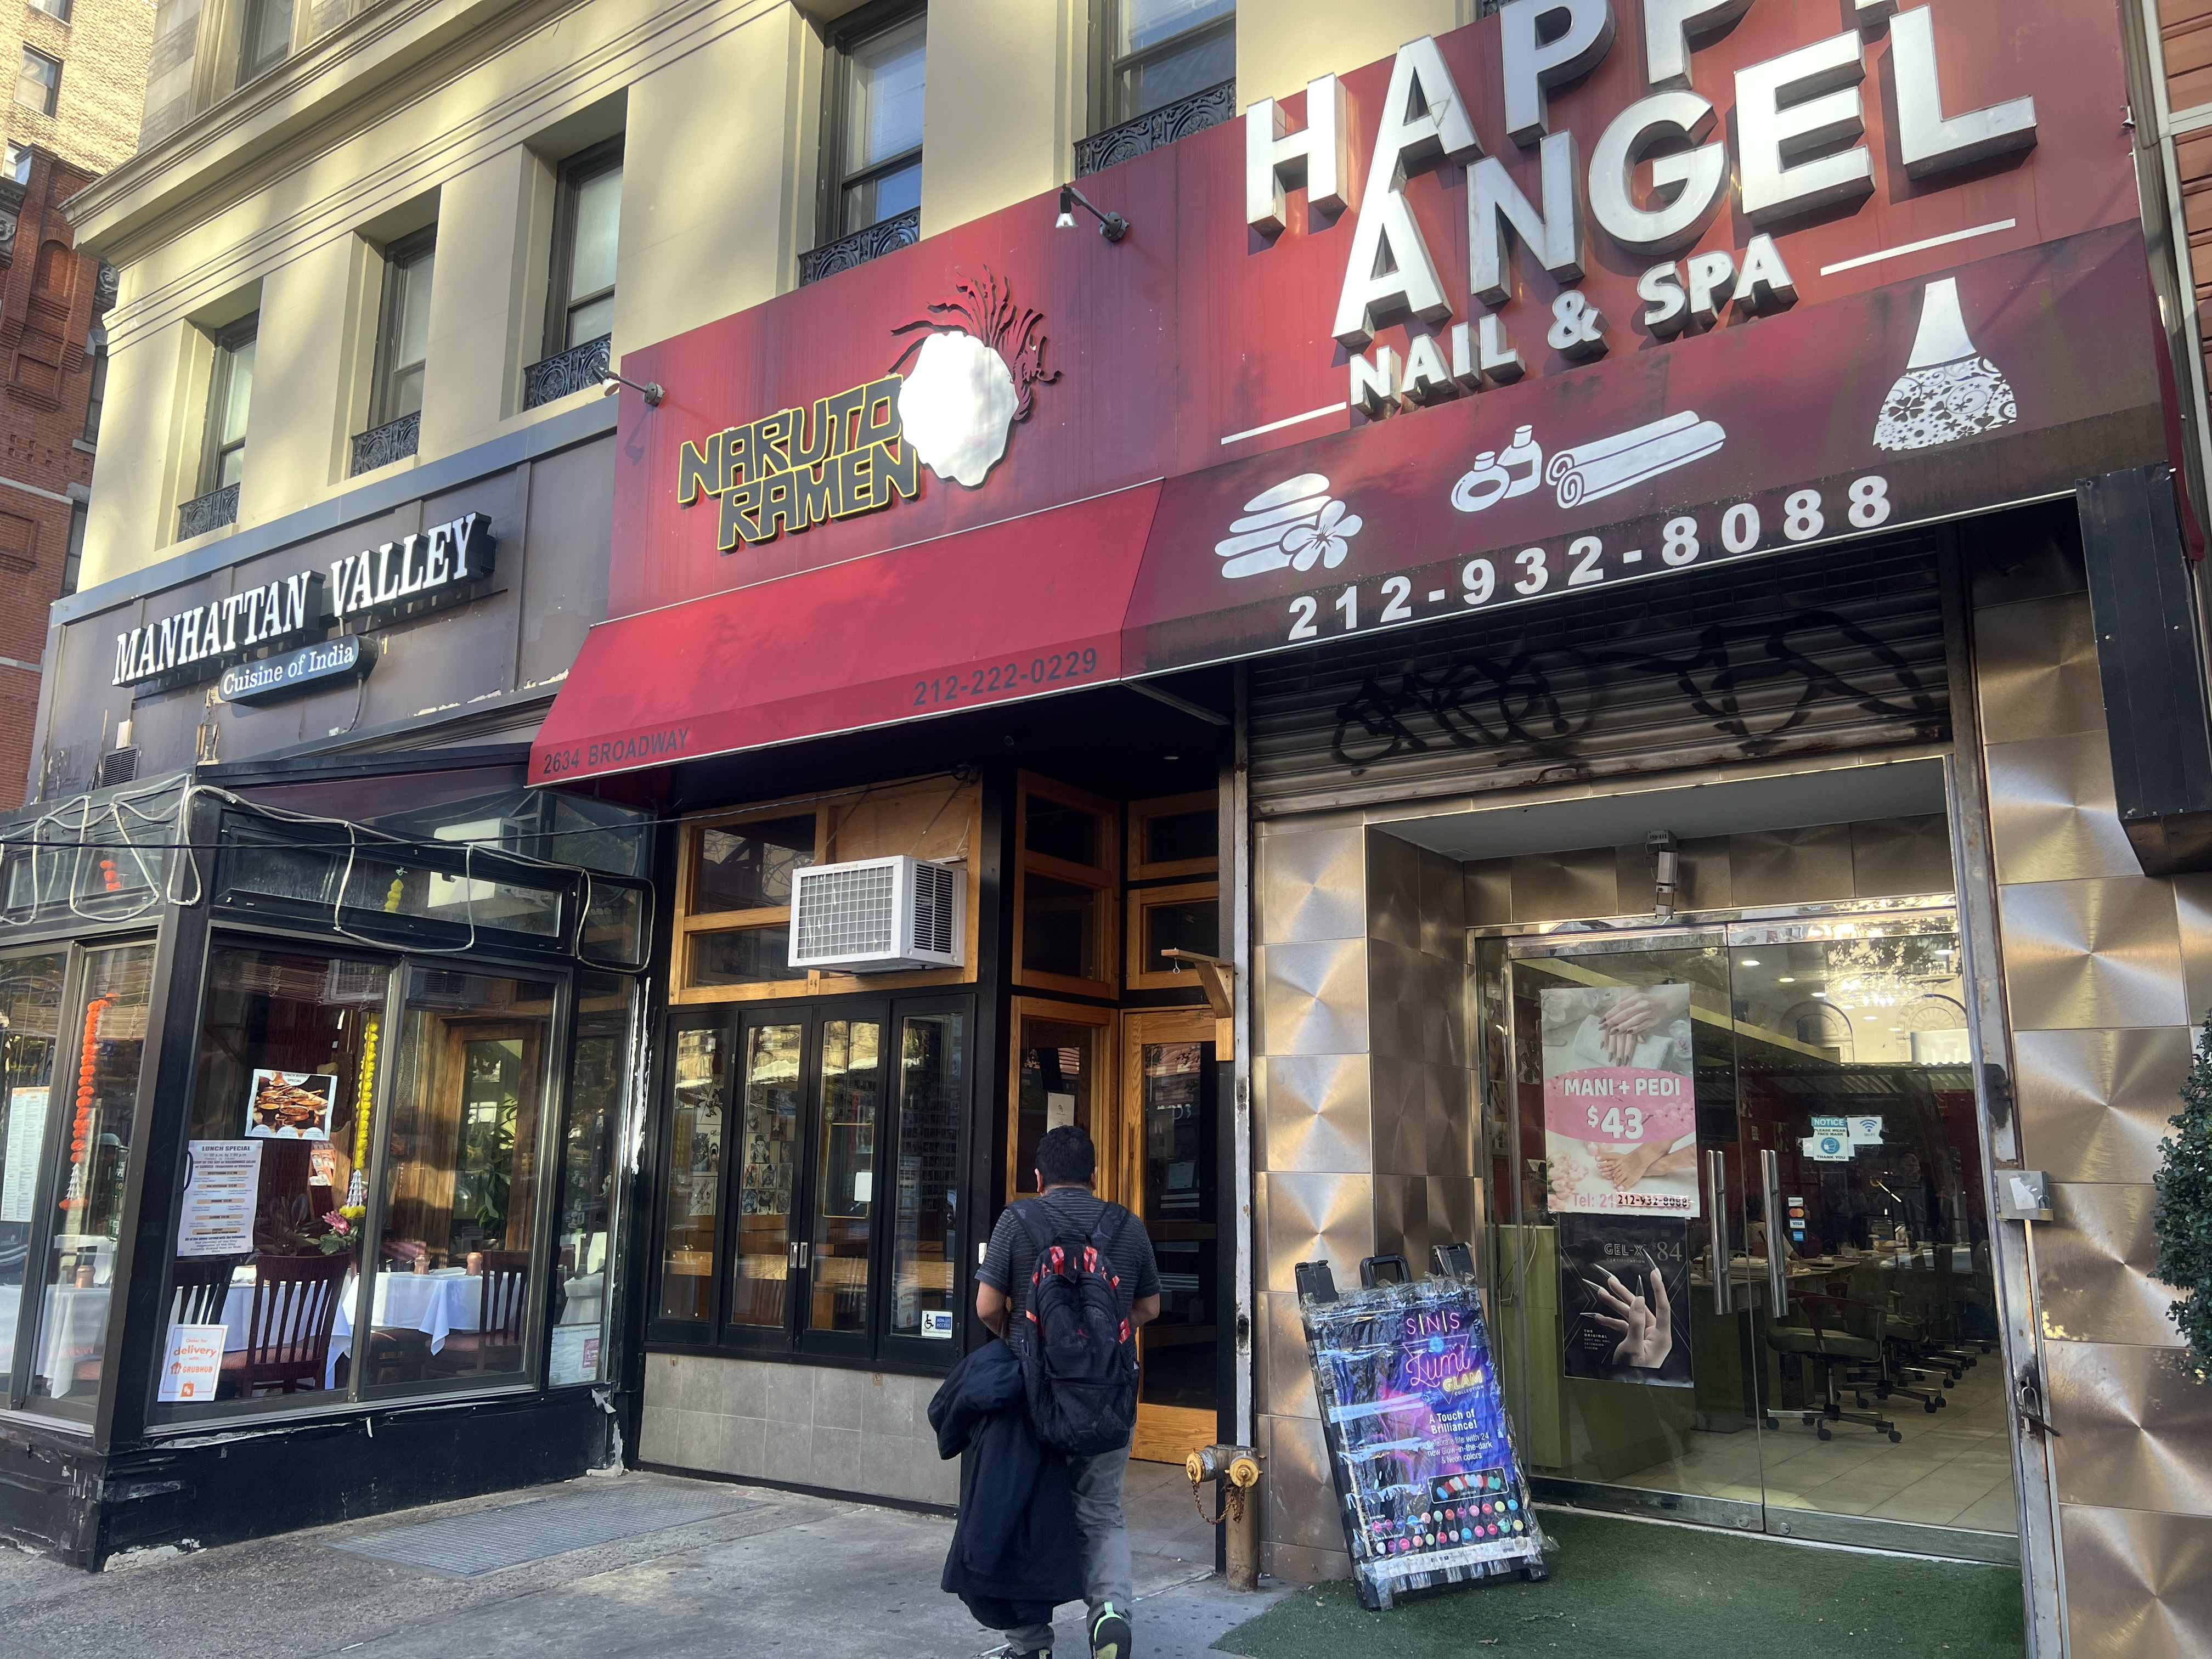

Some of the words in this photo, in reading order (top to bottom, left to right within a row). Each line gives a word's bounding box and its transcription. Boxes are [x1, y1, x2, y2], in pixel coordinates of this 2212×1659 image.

[1247, 0, 1899, 233] HAPP
[1332, 8, 2038, 346] ANGEL
[1350, 313, 1525, 415] NAIL
[1548, 289, 1609, 359] &
[1637, 233, 1798, 337] SPA
[678, 374, 904, 505] NARUTO
[718, 437, 921, 551] RAMEN
[1288, 475, 1891, 641] 212-932-8088
[112, 572, 319, 686] MANHATTAN
[330, 512, 484, 618] VALLEY
[223, 669, 283, 695] Cuisine
[287, 659, 305, 677] of
[309, 643, 354, 672] India
[913, 647, 1097, 706] 212-222-0229
[544, 748, 580, 775] 2634
[588, 727, 690, 766] BROADWAY
[1565, 1078, 1613, 1096] MANI
[1619, 1080, 1630, 1094] +
[1635, 1078, 1680, 1096] PEDI
[1587, 1104, 1644, 1139] $43
[1572, 1193, 1594, 1207] Tel:
[173, 1345, 217, 1358] delivery
[1443, 1370, 1483, 1392] GLAM
[1454, 1385, 1484, 1396] COLLECTION
[1429, 1414, 1436, 1424] A
[1436, 1410, 1463, 1422] Touch
[1466, 1408, 1475, 1419] of
[1430, 1419, 1477, 1434] Brilliance!
[1427, 1438, 1454, 1448] Celebrate
[1481, 1432, 1489, 1440] 24
[1427, 1449, 1440, 1457] new
[1442, 1441, 1493, 1455] Glow-in-the-dark
[1442, 1456, 1446, 1464] &
[1447, 1455, 1463, 1464] Neon
[1464, 1452, 1482, 1461] colors
